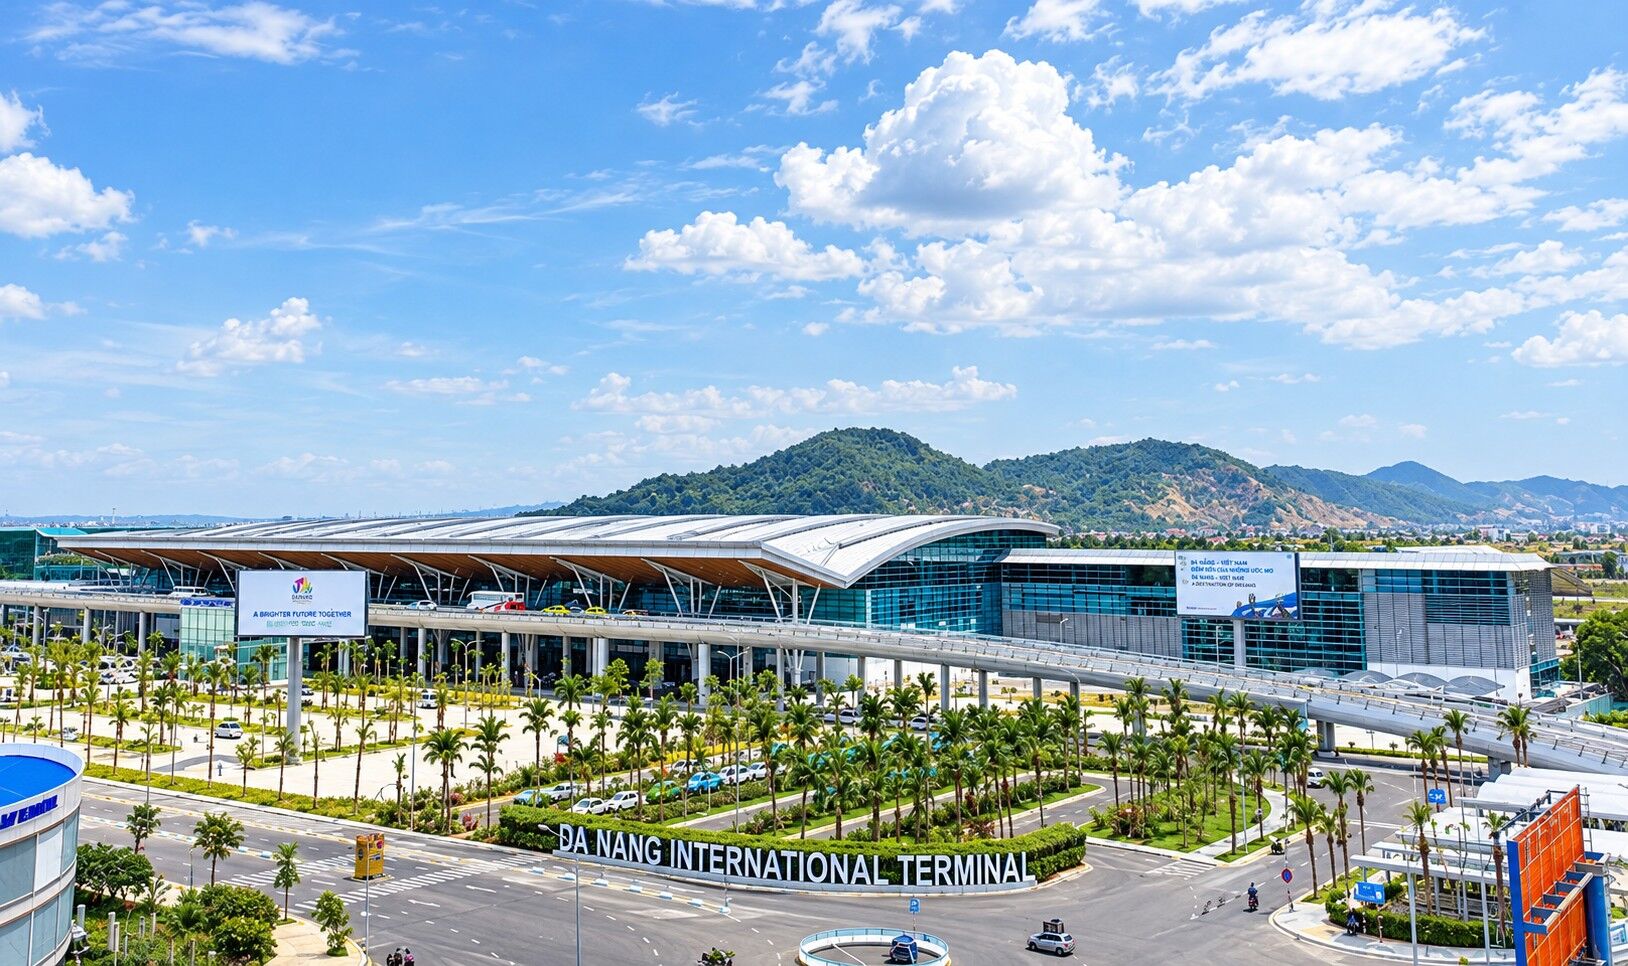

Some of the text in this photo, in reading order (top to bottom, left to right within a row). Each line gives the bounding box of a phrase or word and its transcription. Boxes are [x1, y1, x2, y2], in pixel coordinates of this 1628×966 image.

[559, 823, 1036, 886] DA NANG INTERNATIONAL TERMINAL
